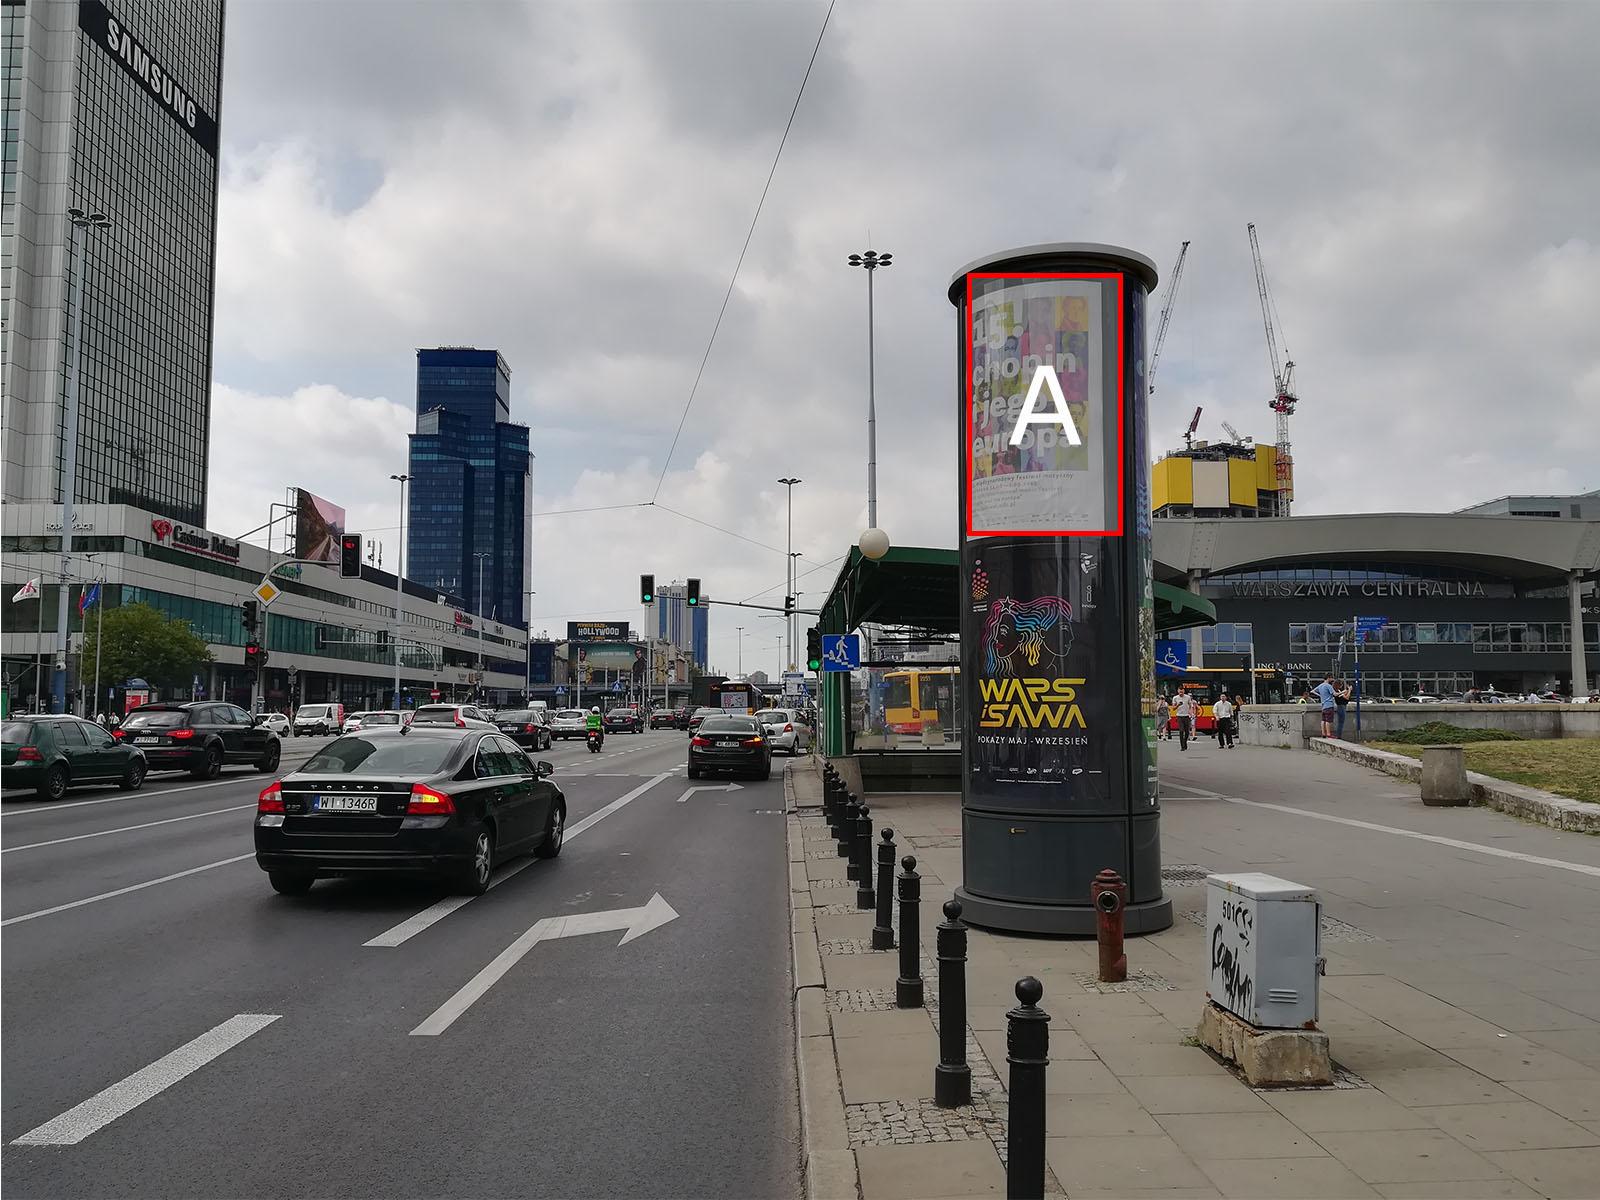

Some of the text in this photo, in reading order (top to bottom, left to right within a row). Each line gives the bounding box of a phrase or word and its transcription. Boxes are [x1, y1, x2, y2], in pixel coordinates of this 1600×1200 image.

[107, 18, 196, 128] SAMSUNG
[1231, 581, 1486, 597] WARSZAWA CENTRALNA
[578, 627, 620, 636] HOLLYWOOD
[979, 678, 1086, 702] WARS
[978, 735, 1006, 744] POKAZY
[1008, 736, 1027, 745] MAJ
[320, 796, 377, 810] WI 1346R
